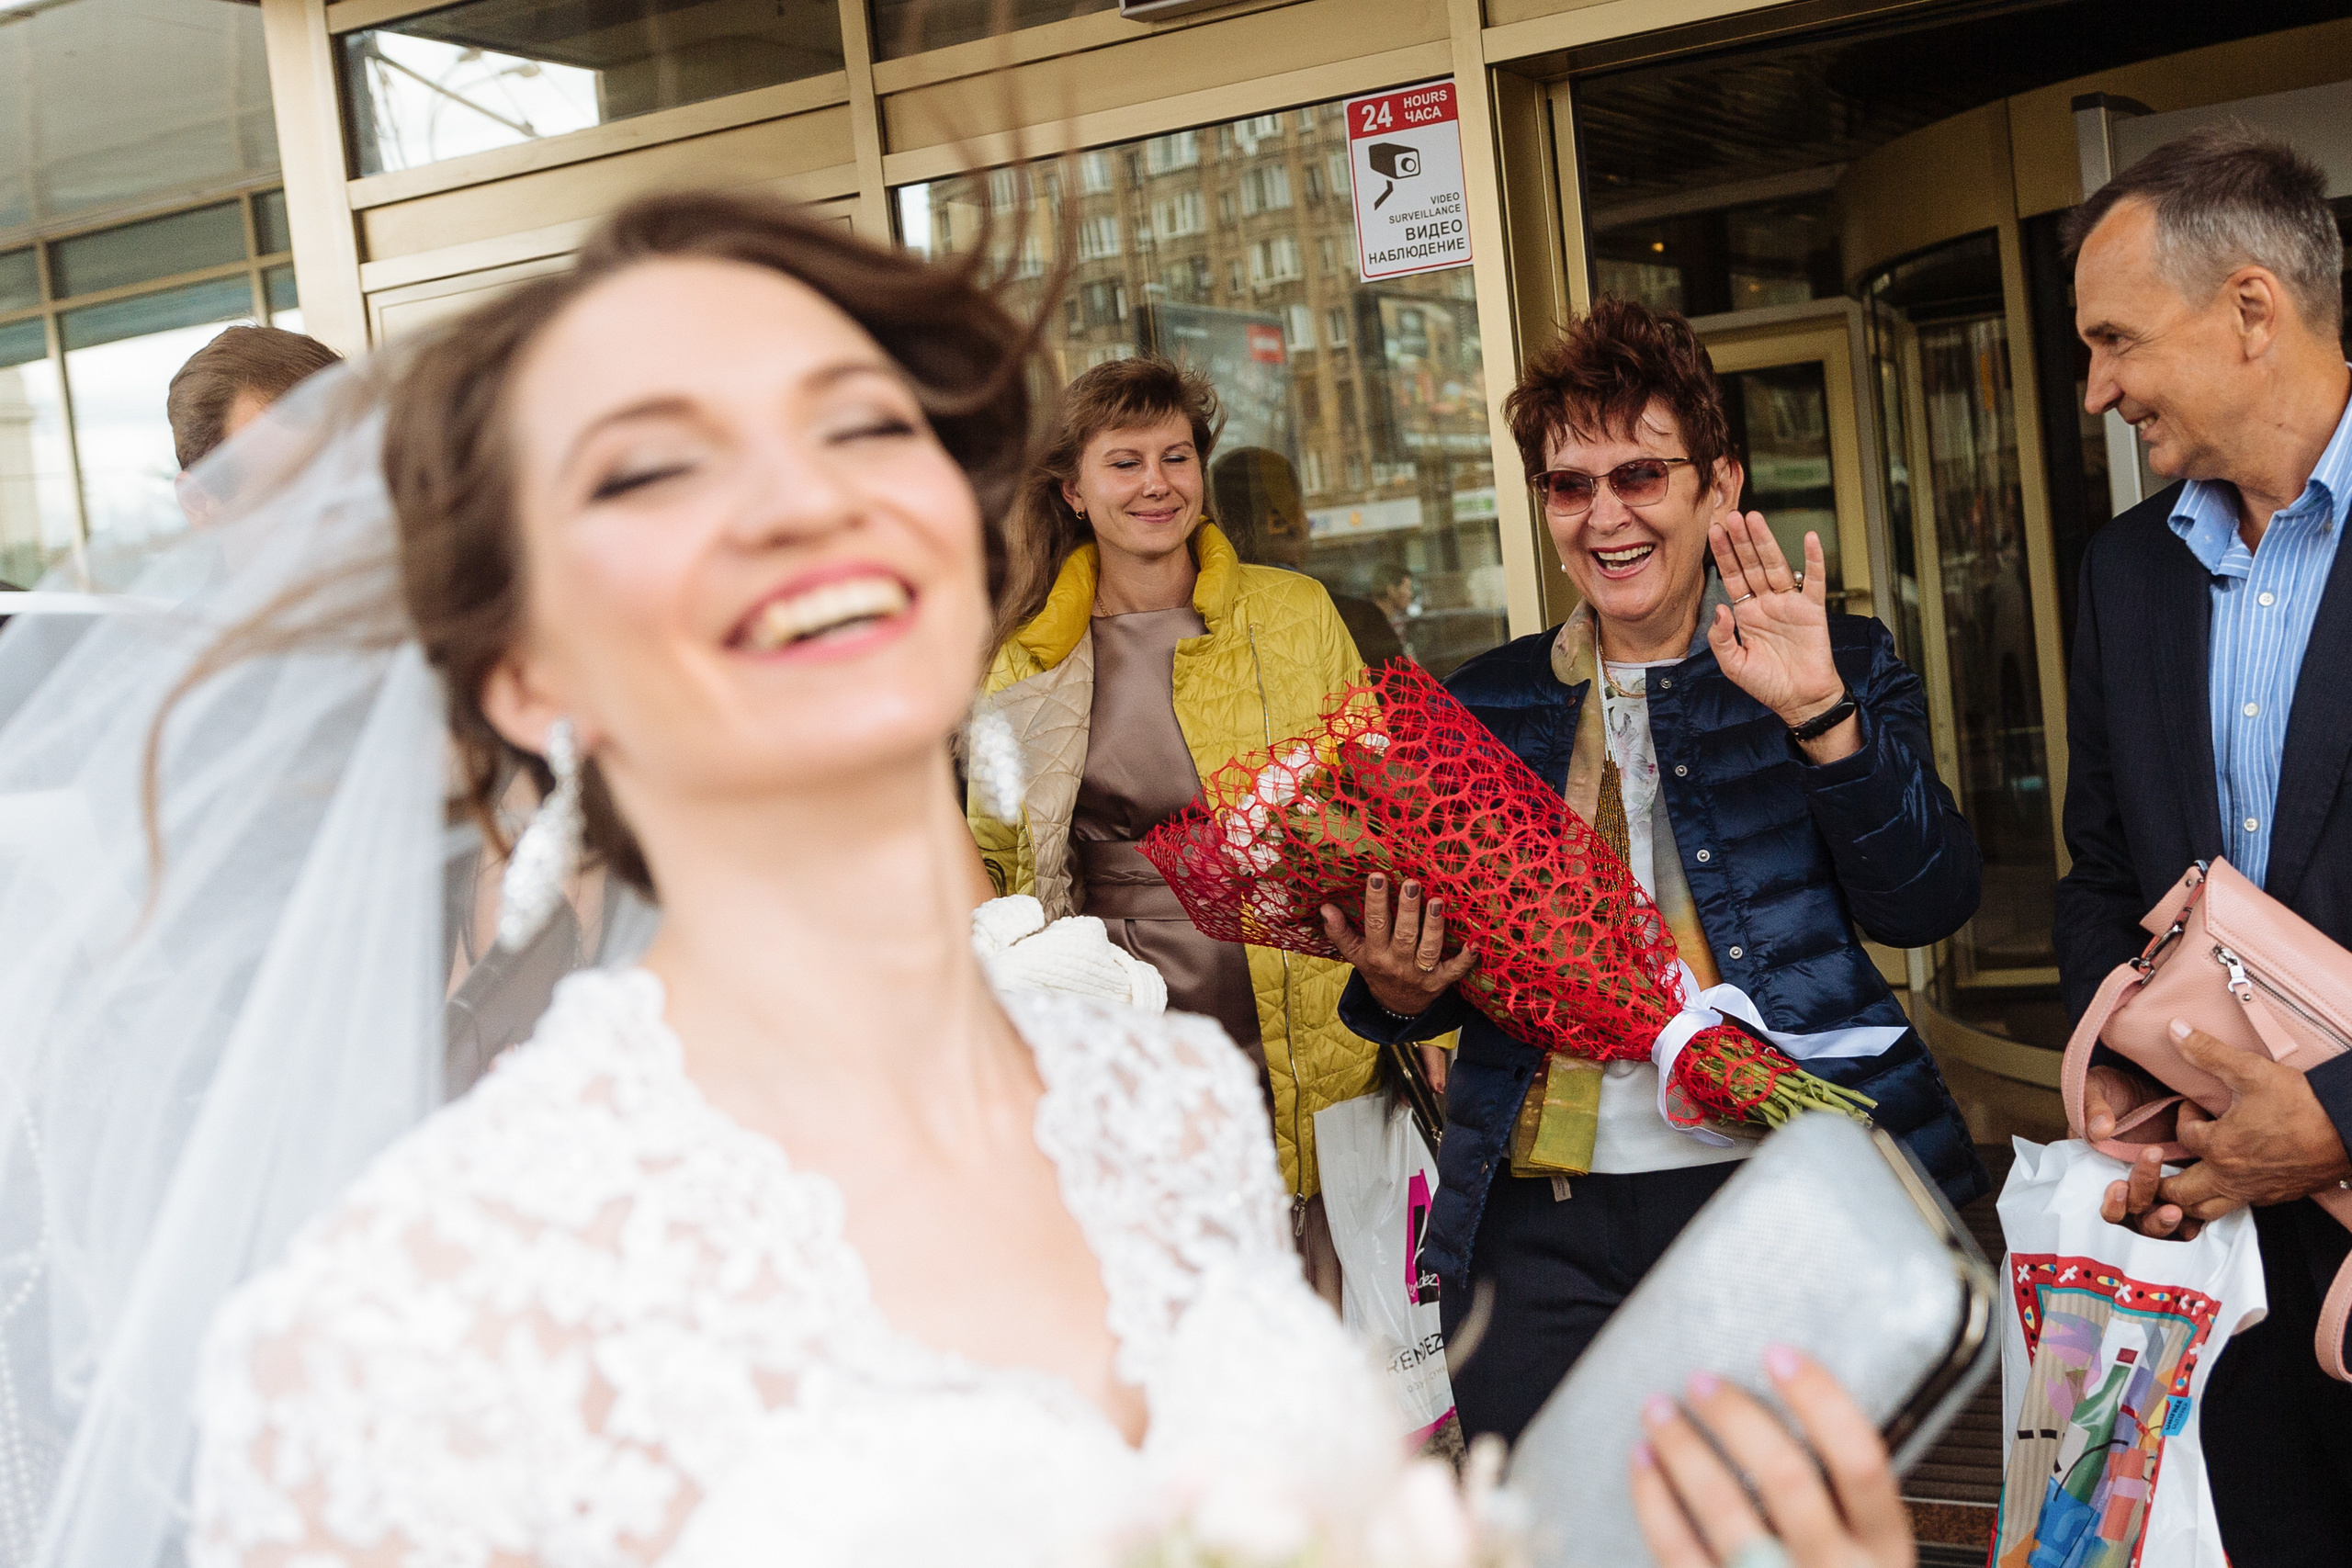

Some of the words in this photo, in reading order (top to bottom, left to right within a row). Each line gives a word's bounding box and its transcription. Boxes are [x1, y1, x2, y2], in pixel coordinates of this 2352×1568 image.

[1403, 89, 1448, 109] HOURS
[1362, 100, 1393, 132] 24
[1405, 106, 1442, 124] ЧАСА
[1430, 191, 1461, 205] VIDEO
[1388, 203, 1462, 224] SURVEILLANCE
[1405, 219, 1463, 242] ВИДЕО
[1368, 237, 1465, 265] НАБЛЮДЕНИЕ
